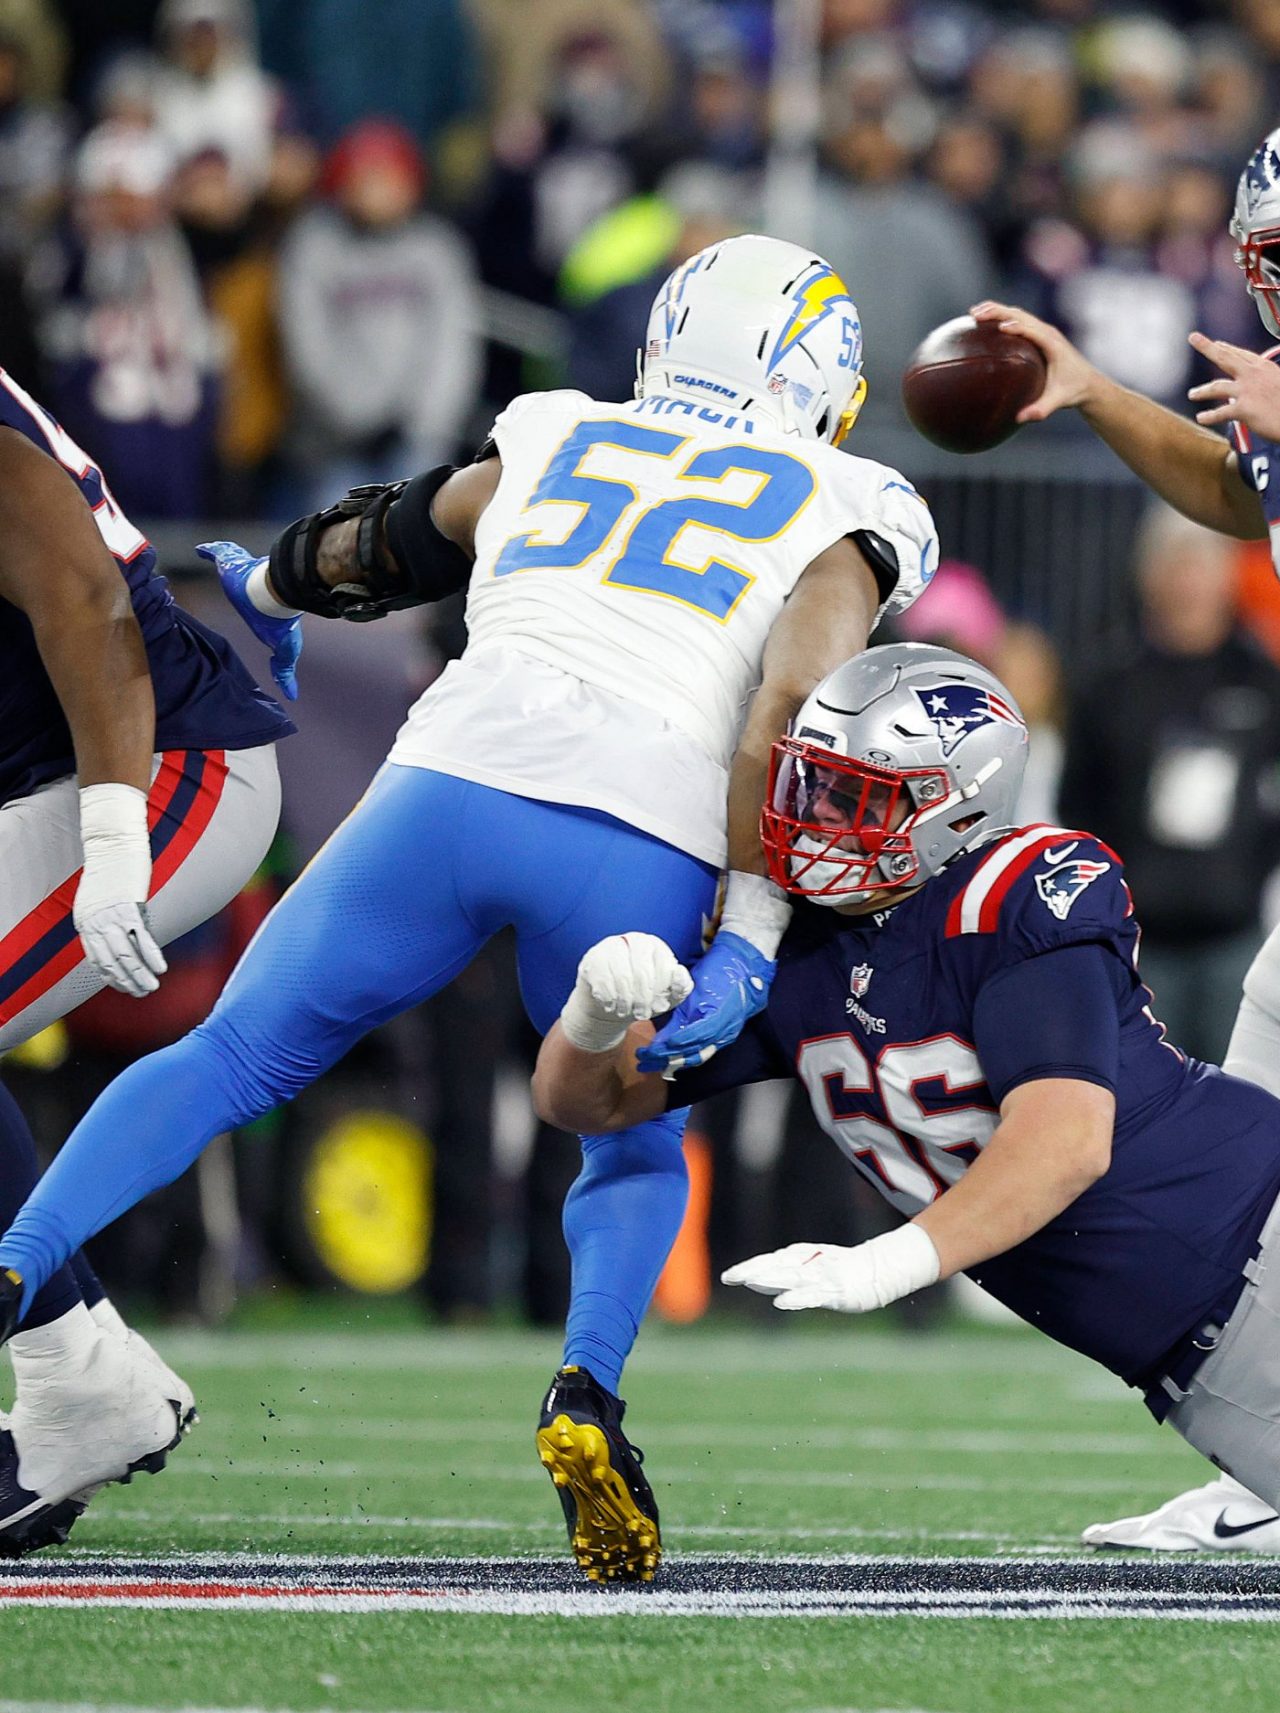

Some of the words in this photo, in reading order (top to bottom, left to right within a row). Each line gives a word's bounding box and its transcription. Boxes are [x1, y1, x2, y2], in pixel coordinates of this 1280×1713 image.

[673, 374, 739, 400] CHARGERS
[493, 419, 818, 624] 52
[1251, 456, 1270, 492] C
[797, 1031, 1000, 1220] 66
